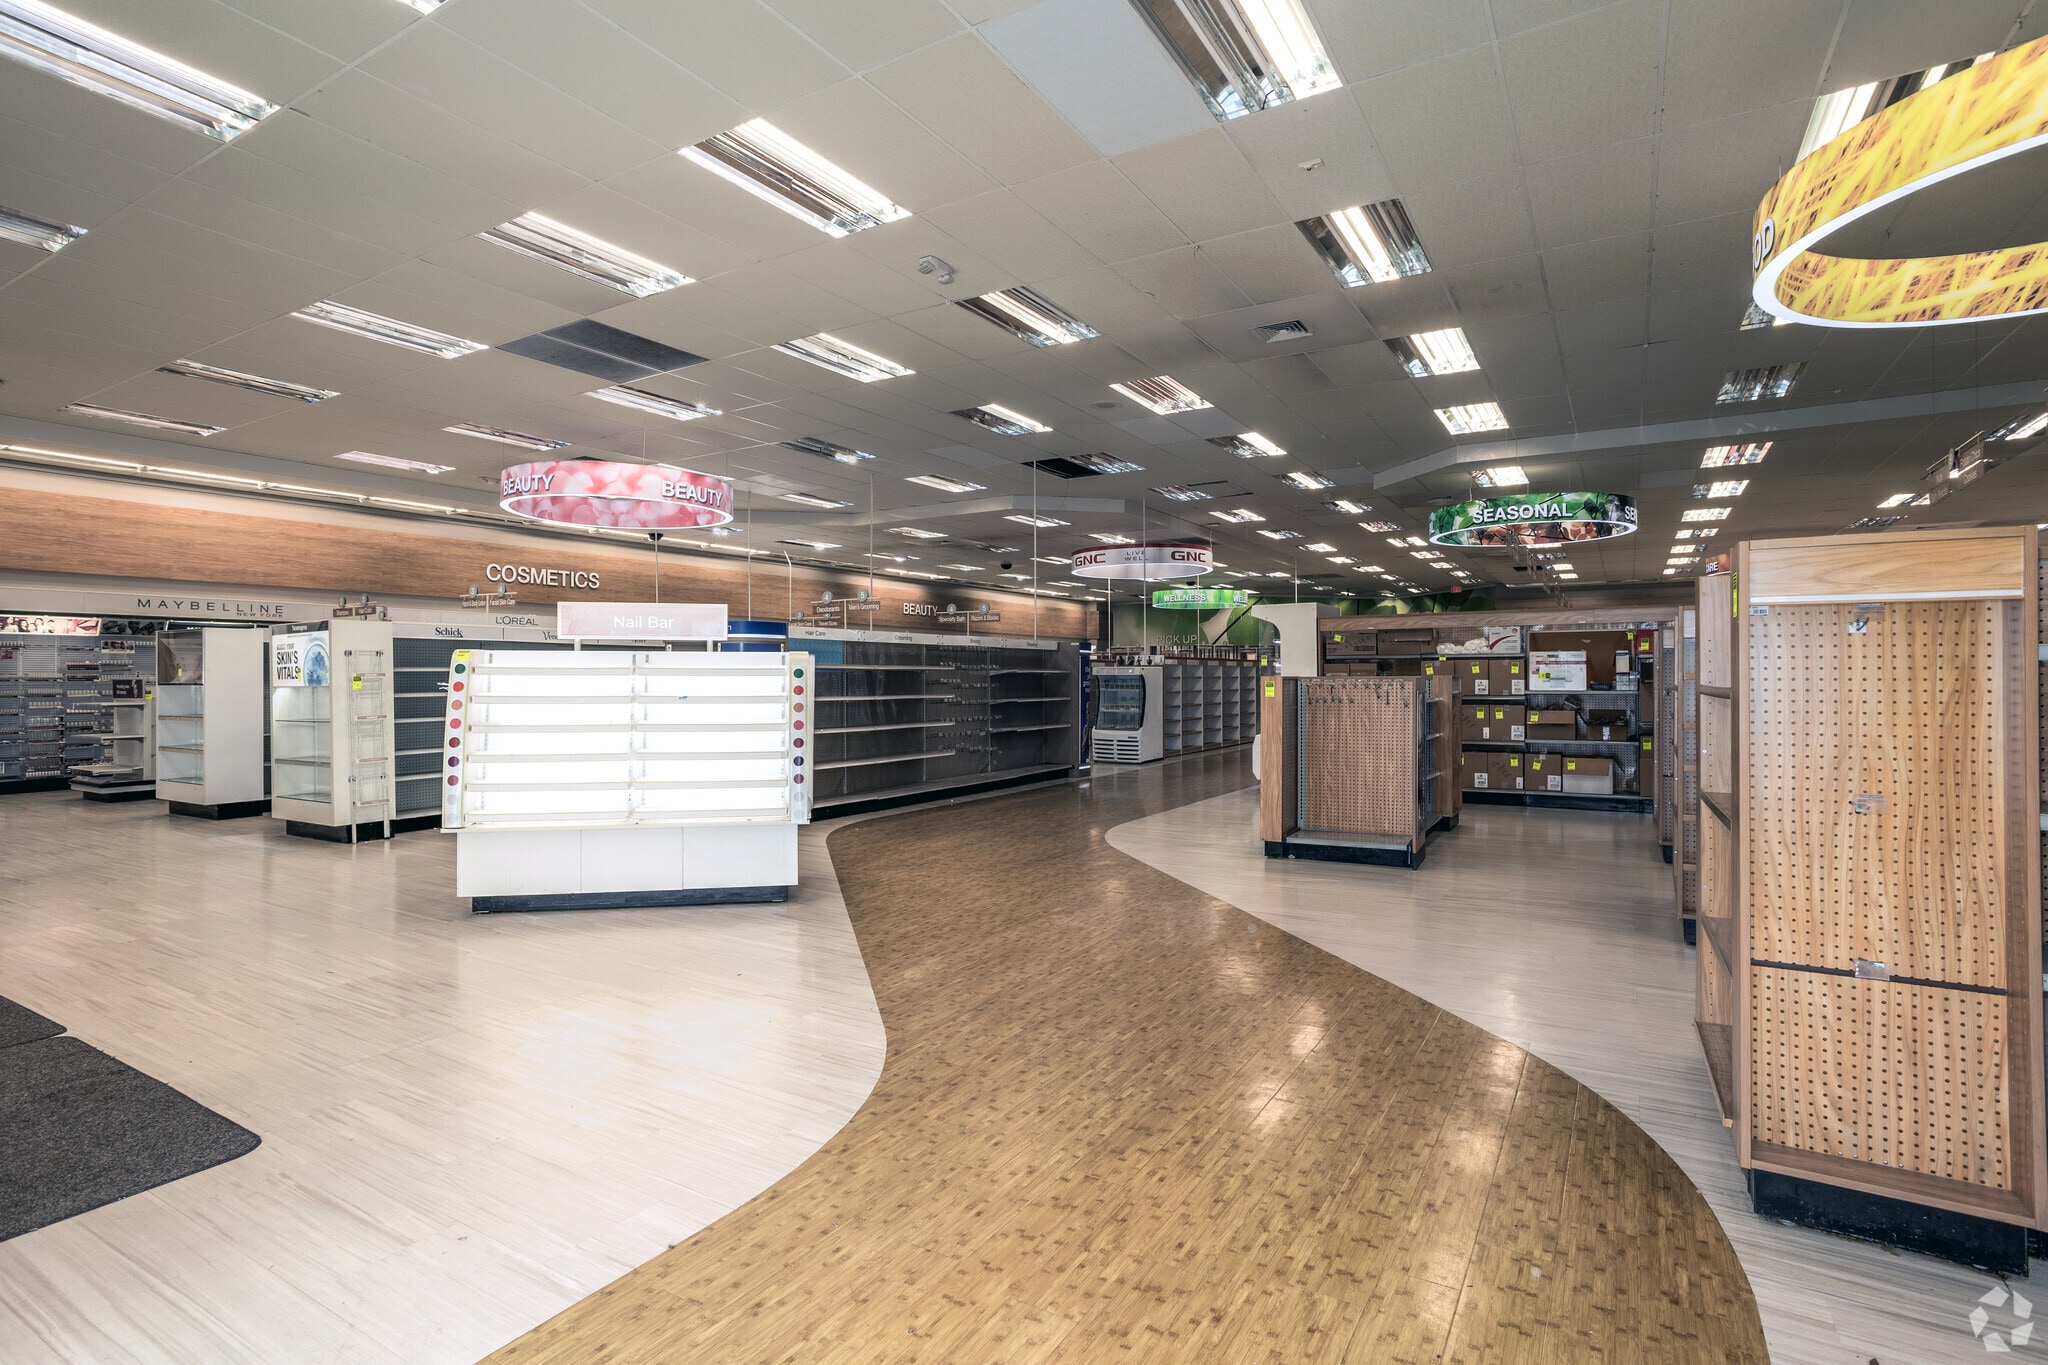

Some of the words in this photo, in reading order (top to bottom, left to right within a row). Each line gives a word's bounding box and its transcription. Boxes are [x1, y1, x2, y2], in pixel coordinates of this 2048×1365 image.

[503, 473, 555, 496] BEAUTY
[661, 480, 723, 507] BEAUTY
[1472, 503, 1574, 524] SEASONAL
[1075, 553, 1106, 567] GNC
[1170, 550, 1206, 563] GNC
[486, 563, 600, 590] COSMETICS
[1164, 593, 1206, 603] WELLNESS
[137, 598, 284, 614] MAYBELLINE
[903, 602, 938, 617] BEAUTY
[613, 616, 642, 628] Nail
[648, 616, 674, 628] Bar
[434, 626, 464, 638] Schick
[542, 631, 558, 641] Ven
[1157, 635, 1180, 645] PICK
[1182, 634, 1197, 644] UP
[276, 651, 299, 665] SKIN'S
[276, 666, 299, 680] VITALS
